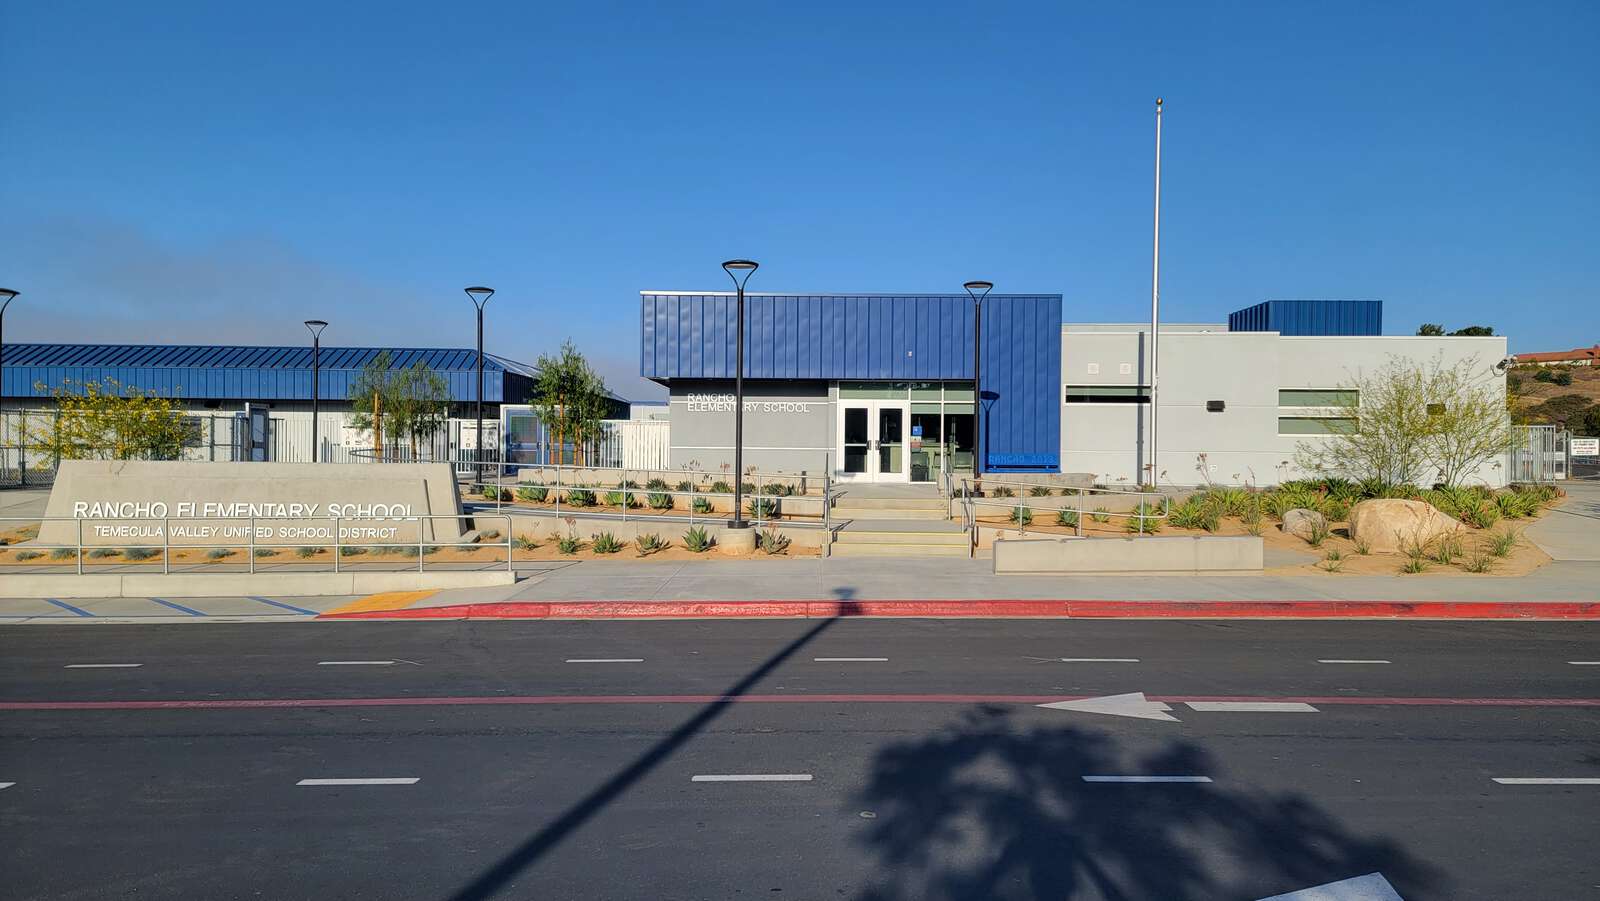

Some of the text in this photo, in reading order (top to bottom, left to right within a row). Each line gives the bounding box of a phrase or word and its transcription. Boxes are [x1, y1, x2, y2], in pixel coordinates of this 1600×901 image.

[686, 393, 735, 402] RANCHO
[686, 402, 810, 412] ELEMENTRY SCHOOL
[73, 501, 417, 521] RANCHO ELEMENTARY SCHOOL
[94, 526, 398, 539] TEMECULA VALLEY UNIFED SCHOOL DISTRICT
